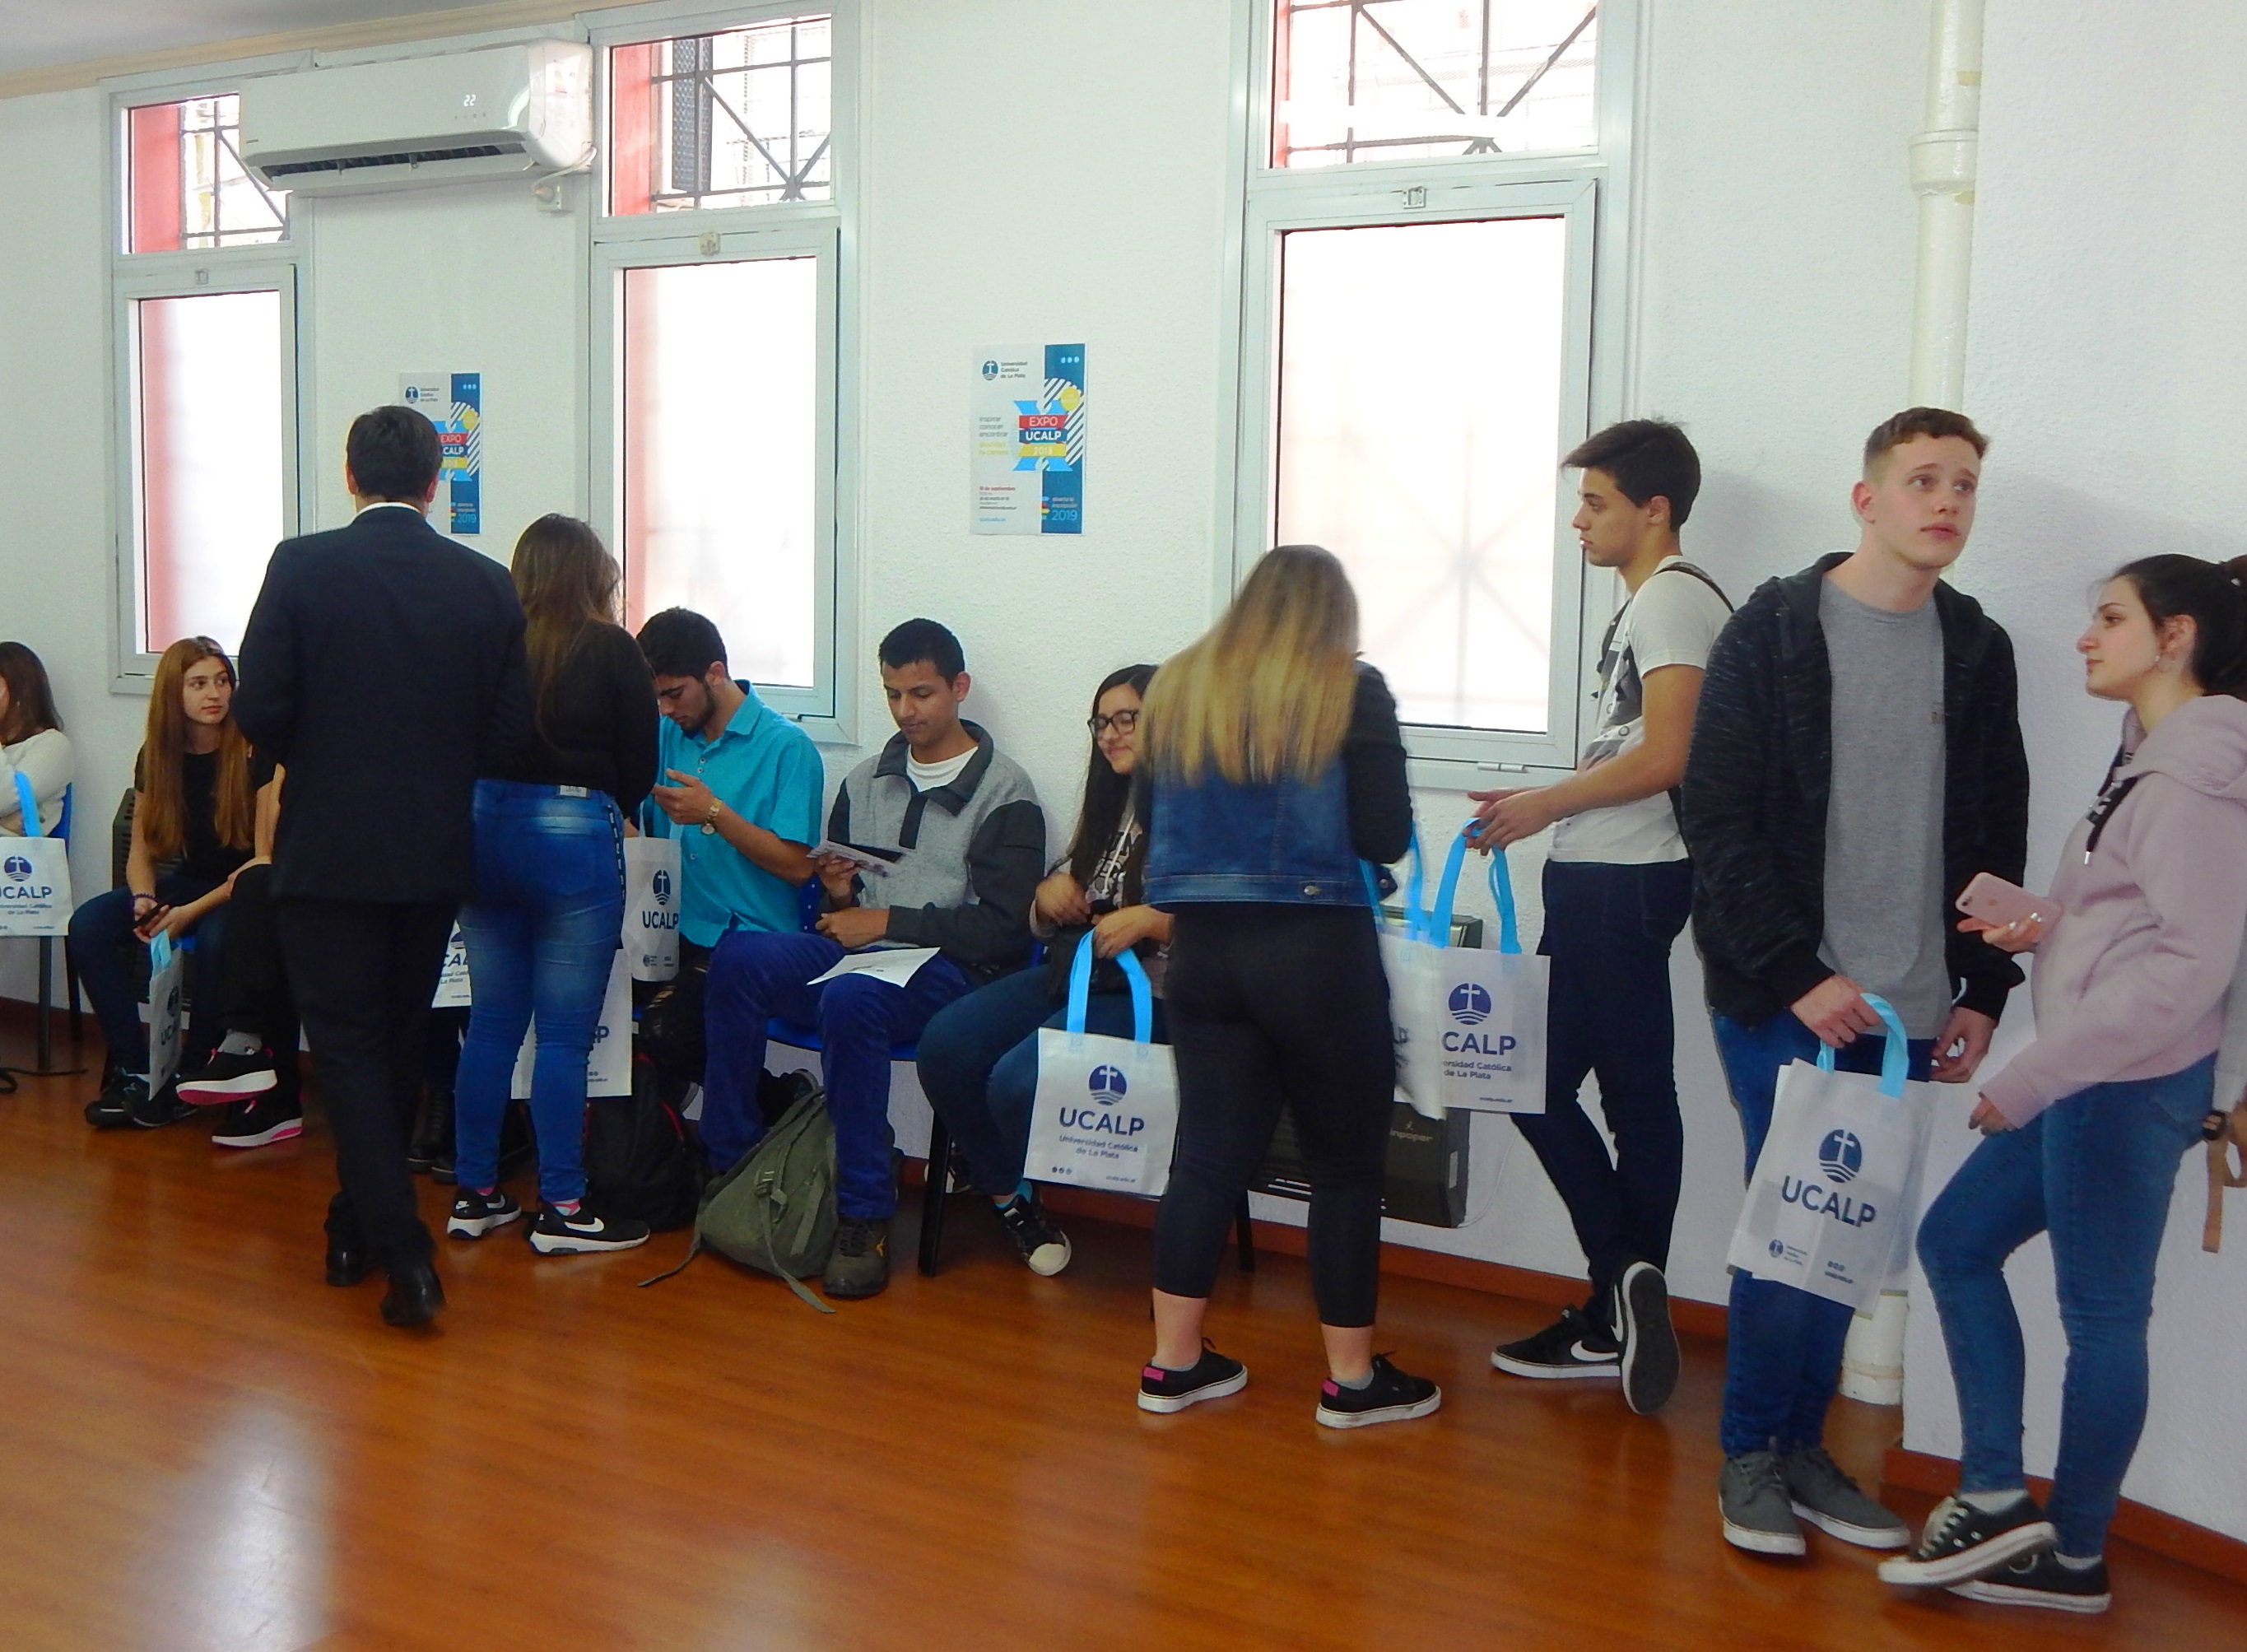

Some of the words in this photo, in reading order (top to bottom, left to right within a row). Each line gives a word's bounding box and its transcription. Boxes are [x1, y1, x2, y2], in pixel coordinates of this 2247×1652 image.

[463, 94, 477, 107] 22
[1029, 416, 1058, 427] EXPO
[440, 434, 462, 444] EXPO
[1025, 430, 1062, 441] UCALP
[442, 446, 464, 455] CALP
[1051, 510, 1078, 521] 2019
[0, 886, 52, 899] CALP
[642, 910, 679, 930] UCALP
[1441, 1031, 1517, 1056] CALP
[1443, 1060, 1475, 1068] ersidad
[1477, 1062, 1512, 1072] Católica
[1469, 1071, 1491, 1080] Plata
[1058, 1106, 1145, 1137] UCALP
[1058, 1134, 1106, 1148] Universidad
[1108, 1142, 1138, 1152] Católica
[1088, 1148, 1099, 1156] La
[1100, 1150, 1119, 1159] Plata
[1781, 1175, 1877, 1228] UCALP
